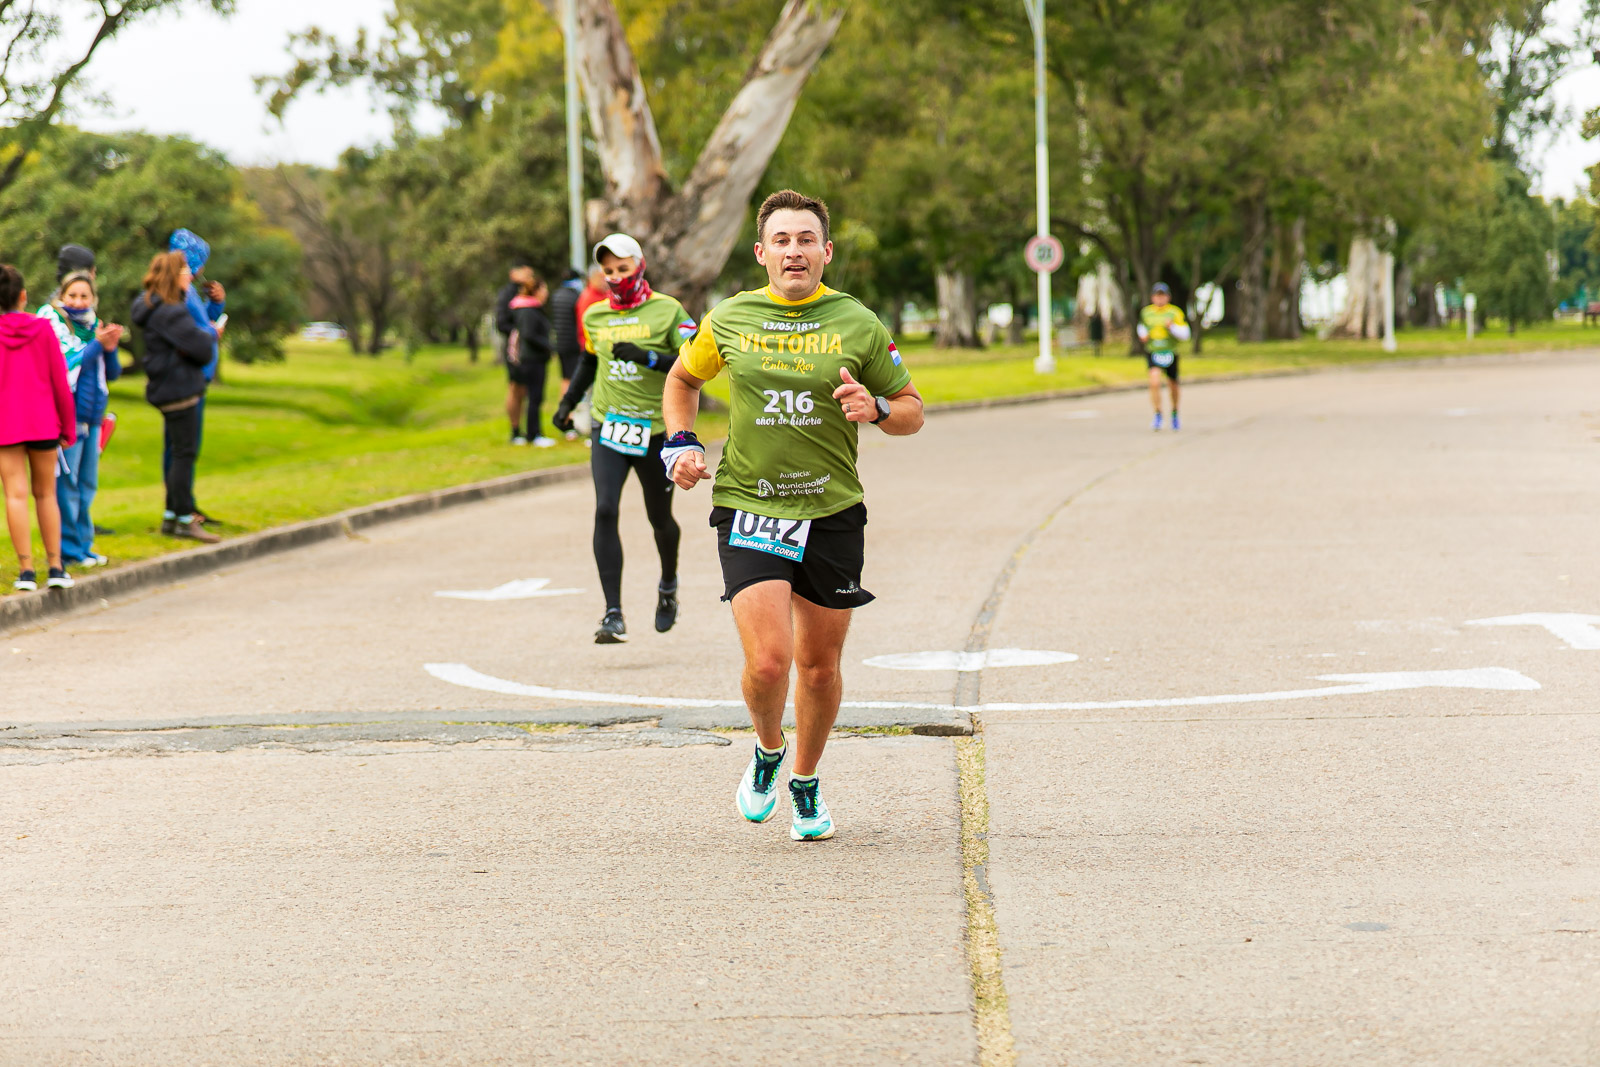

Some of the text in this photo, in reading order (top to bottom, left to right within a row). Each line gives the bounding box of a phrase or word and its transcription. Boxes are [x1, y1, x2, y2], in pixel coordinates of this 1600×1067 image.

[739, 333, 843, 355] VICTORIA
[608, 360, 638, 375] 216
[761, 355, 790, 371] Entre
[763, 389, 814, 413] 216
[755, 413, 823, 426] años de historia
[608, 419, 645, 446] 123
[776, 473, 831, 490] Municipalidad
[780, 470, 812, 479] Auspicia:
[779, 487, 825, 497] de Victoria
[738, 512, 803, 548] 042
[733, 538, 800, 559] DIAMANTE CORRE
